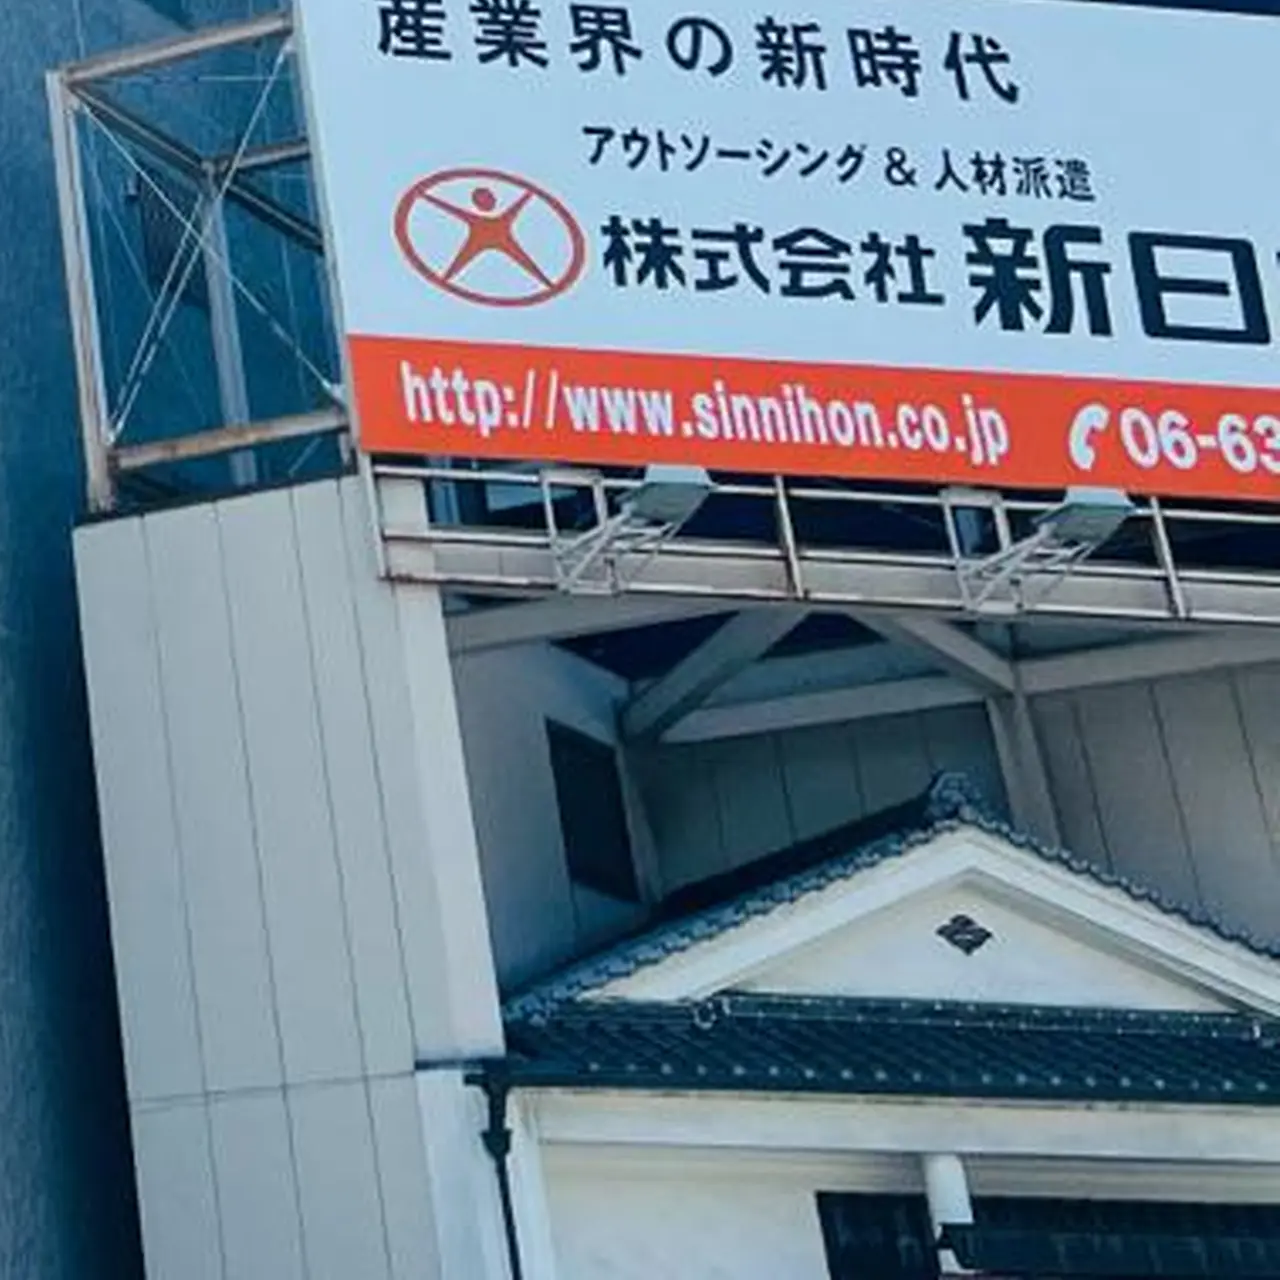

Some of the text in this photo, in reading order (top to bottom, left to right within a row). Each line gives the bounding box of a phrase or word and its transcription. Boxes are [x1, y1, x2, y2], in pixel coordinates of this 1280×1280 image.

[581, 124, 1096, 203] アウトソーシング & 人材派遣
[399, 360, 1010, 467] http://www.sinnihon.co.jp
